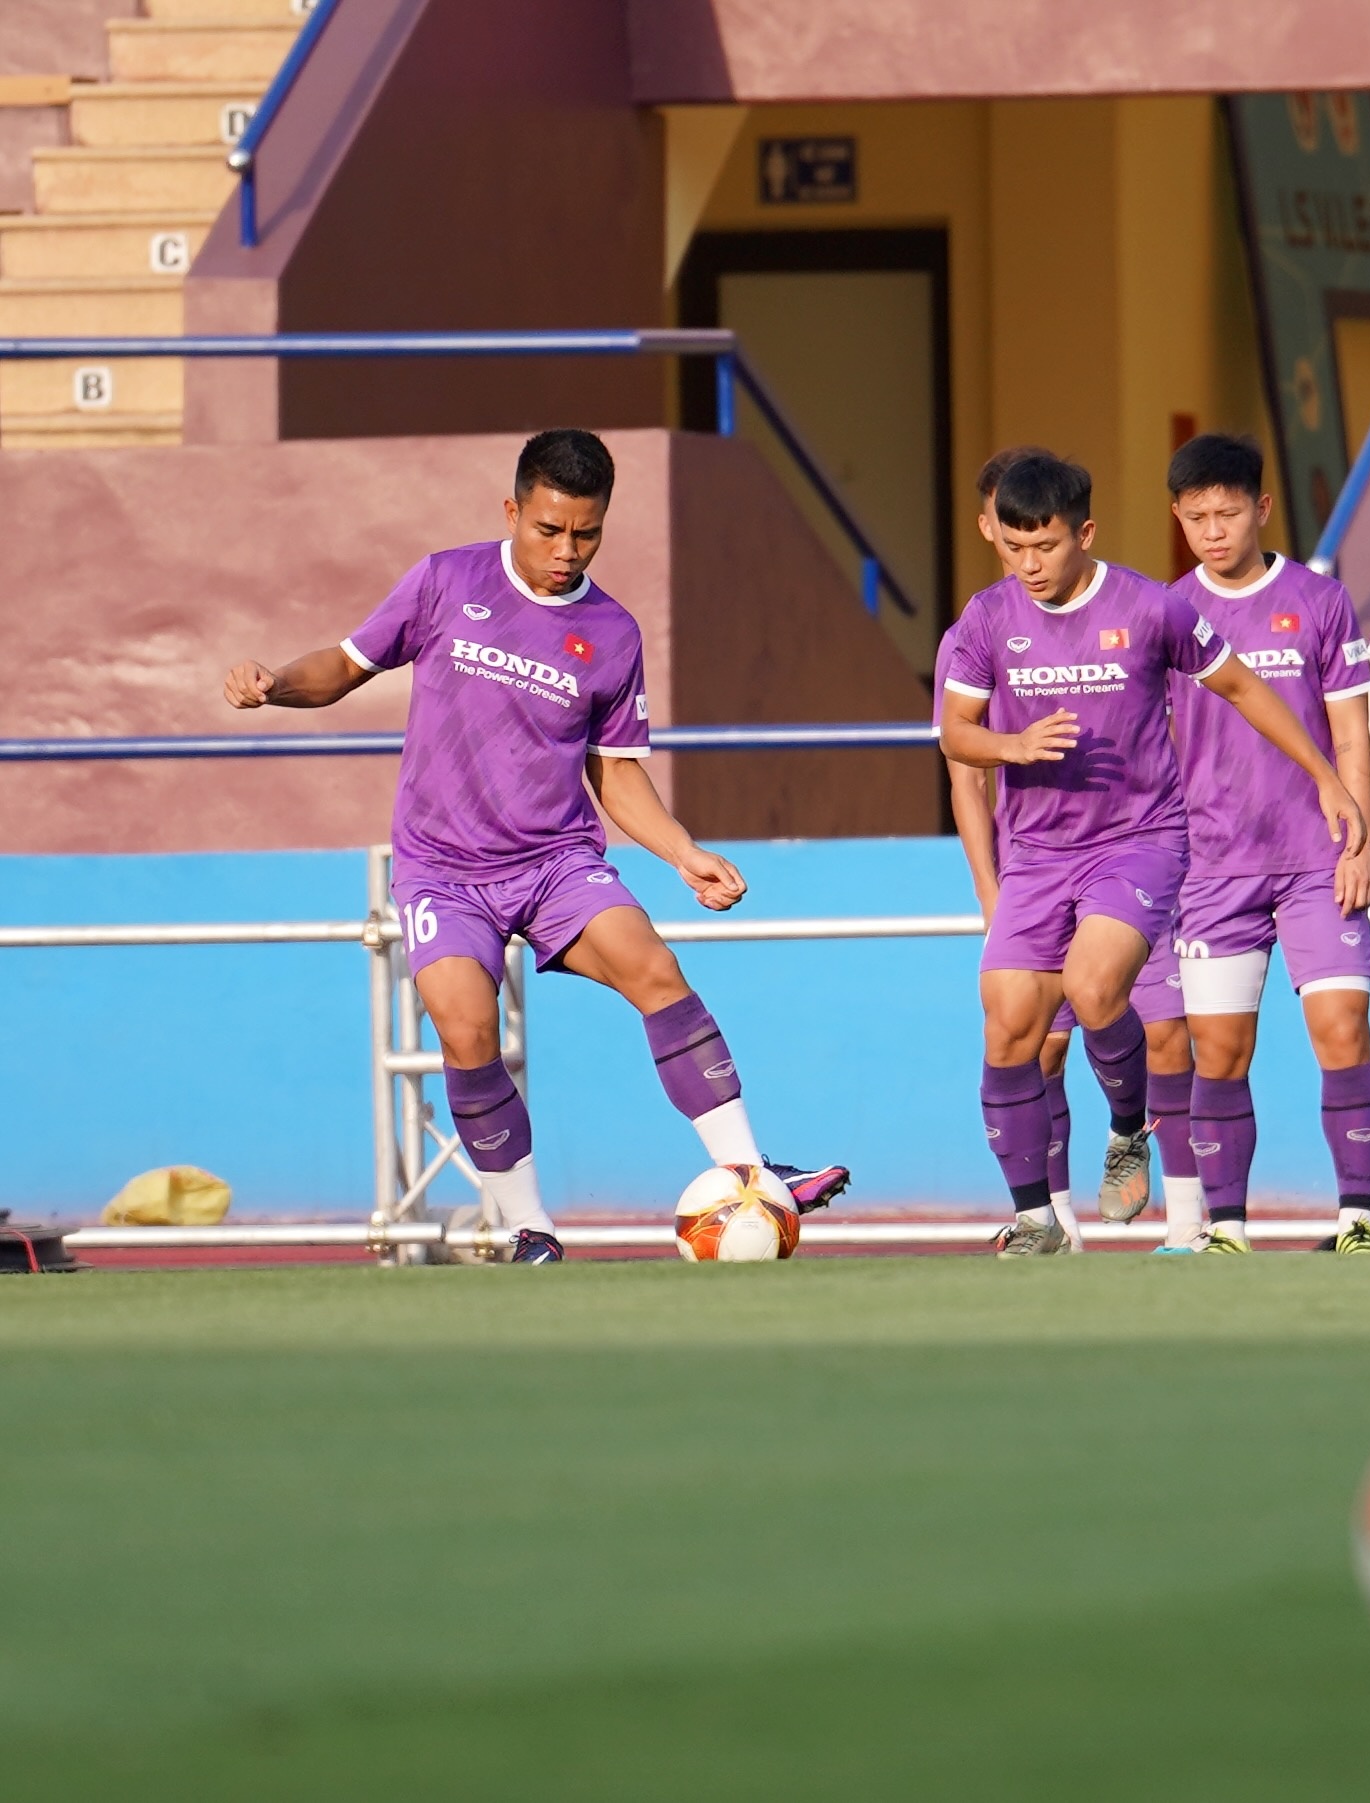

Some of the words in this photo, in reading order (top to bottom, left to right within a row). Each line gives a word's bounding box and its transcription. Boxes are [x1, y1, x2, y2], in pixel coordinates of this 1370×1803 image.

[159, 238, 180, 267] C
[82, 373, 104, 400] B
[450, 638, 579, 698] HONDA
[1236, 648, 1305, 669] NDA
[453, 661, 475, 676] The
[475, 664, 514, 687] Power
[515, 679, 529, 691] of
[529, 683, 572, 709] Dreams
[1006, 663, 1129, 686] HONDA
[1260, 668, 1302, 680] Dreams
[1013, 687, 1033, 698] The
[1034, 686, 1068, 697] Power
[1070, 684, 1081, 695] of
[1083, 682, 1125, 695] Dreams
[403, 896, 438, 953] 16
